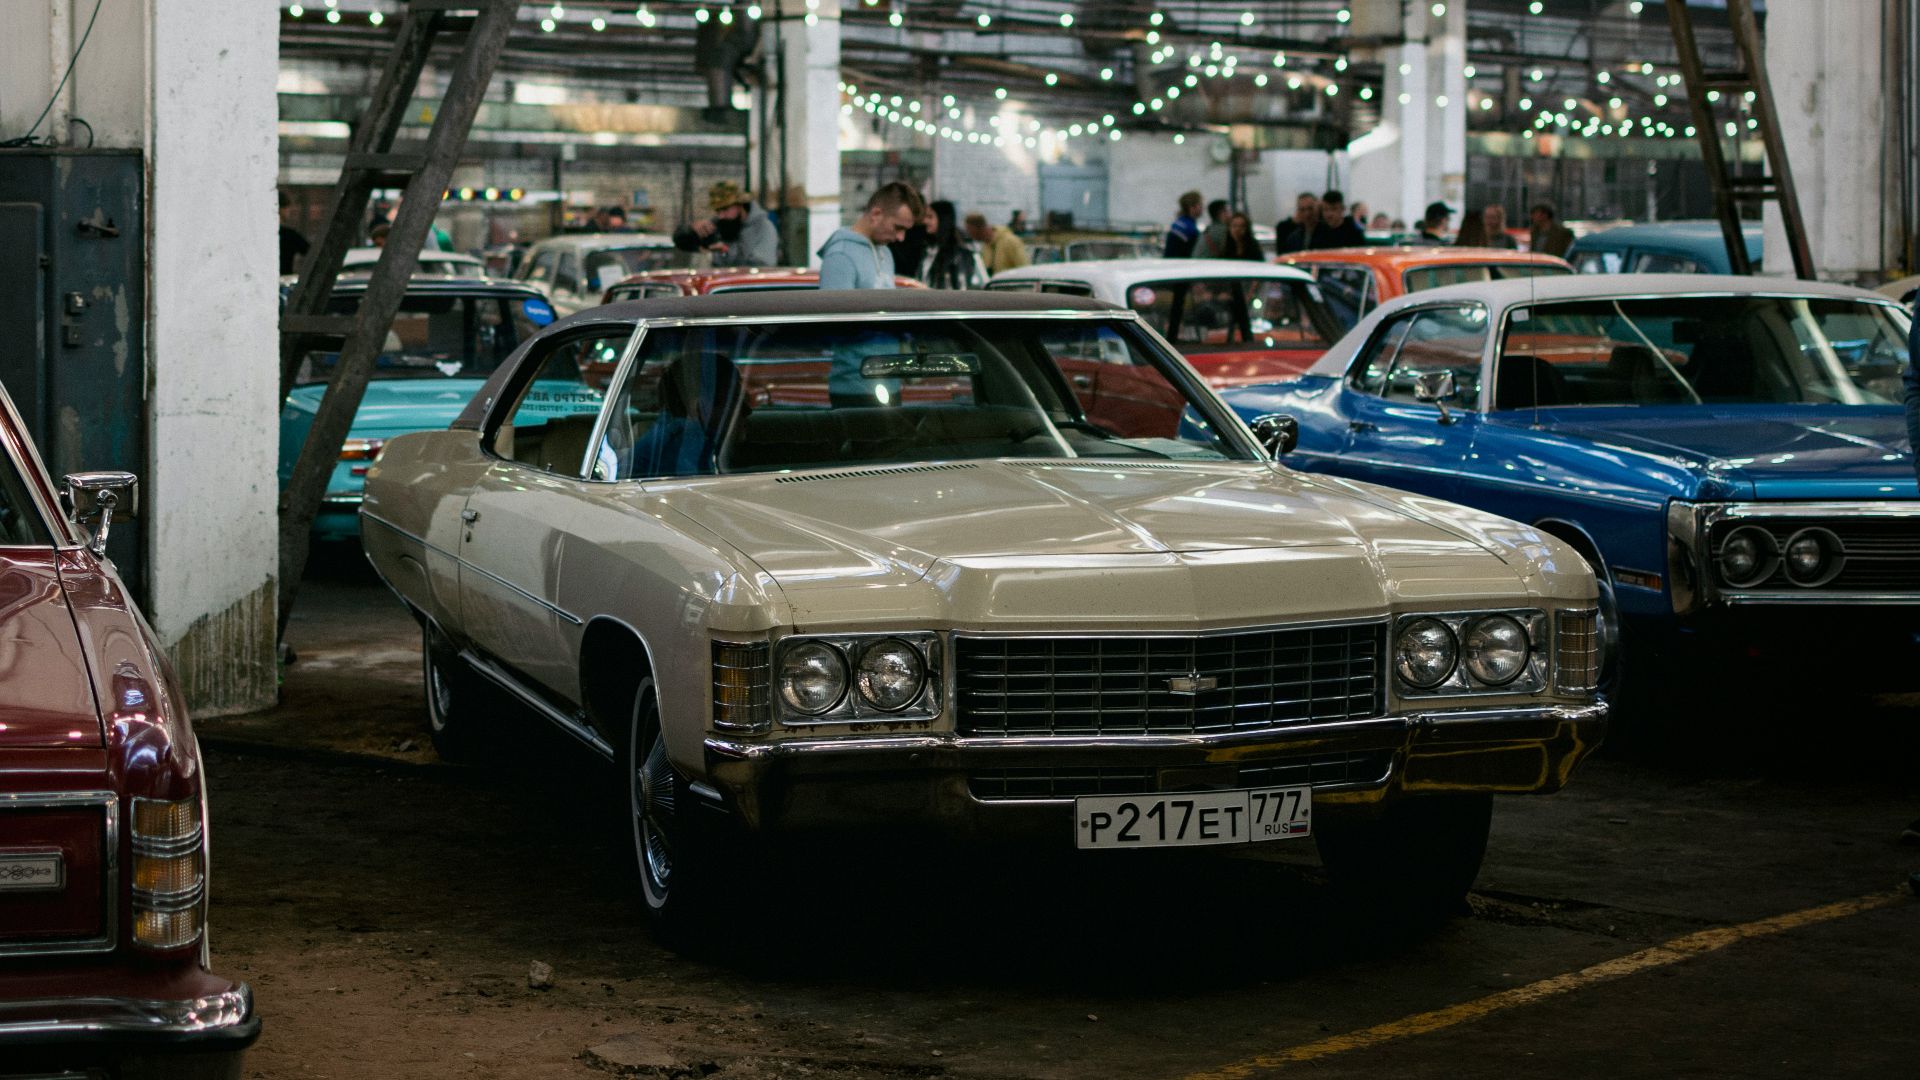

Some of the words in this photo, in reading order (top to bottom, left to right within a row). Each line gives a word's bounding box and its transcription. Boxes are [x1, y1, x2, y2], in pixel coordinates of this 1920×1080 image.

[1090, 800, 1243, 842] P217ET
[1252, 791, 1302, 824] 777
[1264, 823, 1289, 835] RUS
